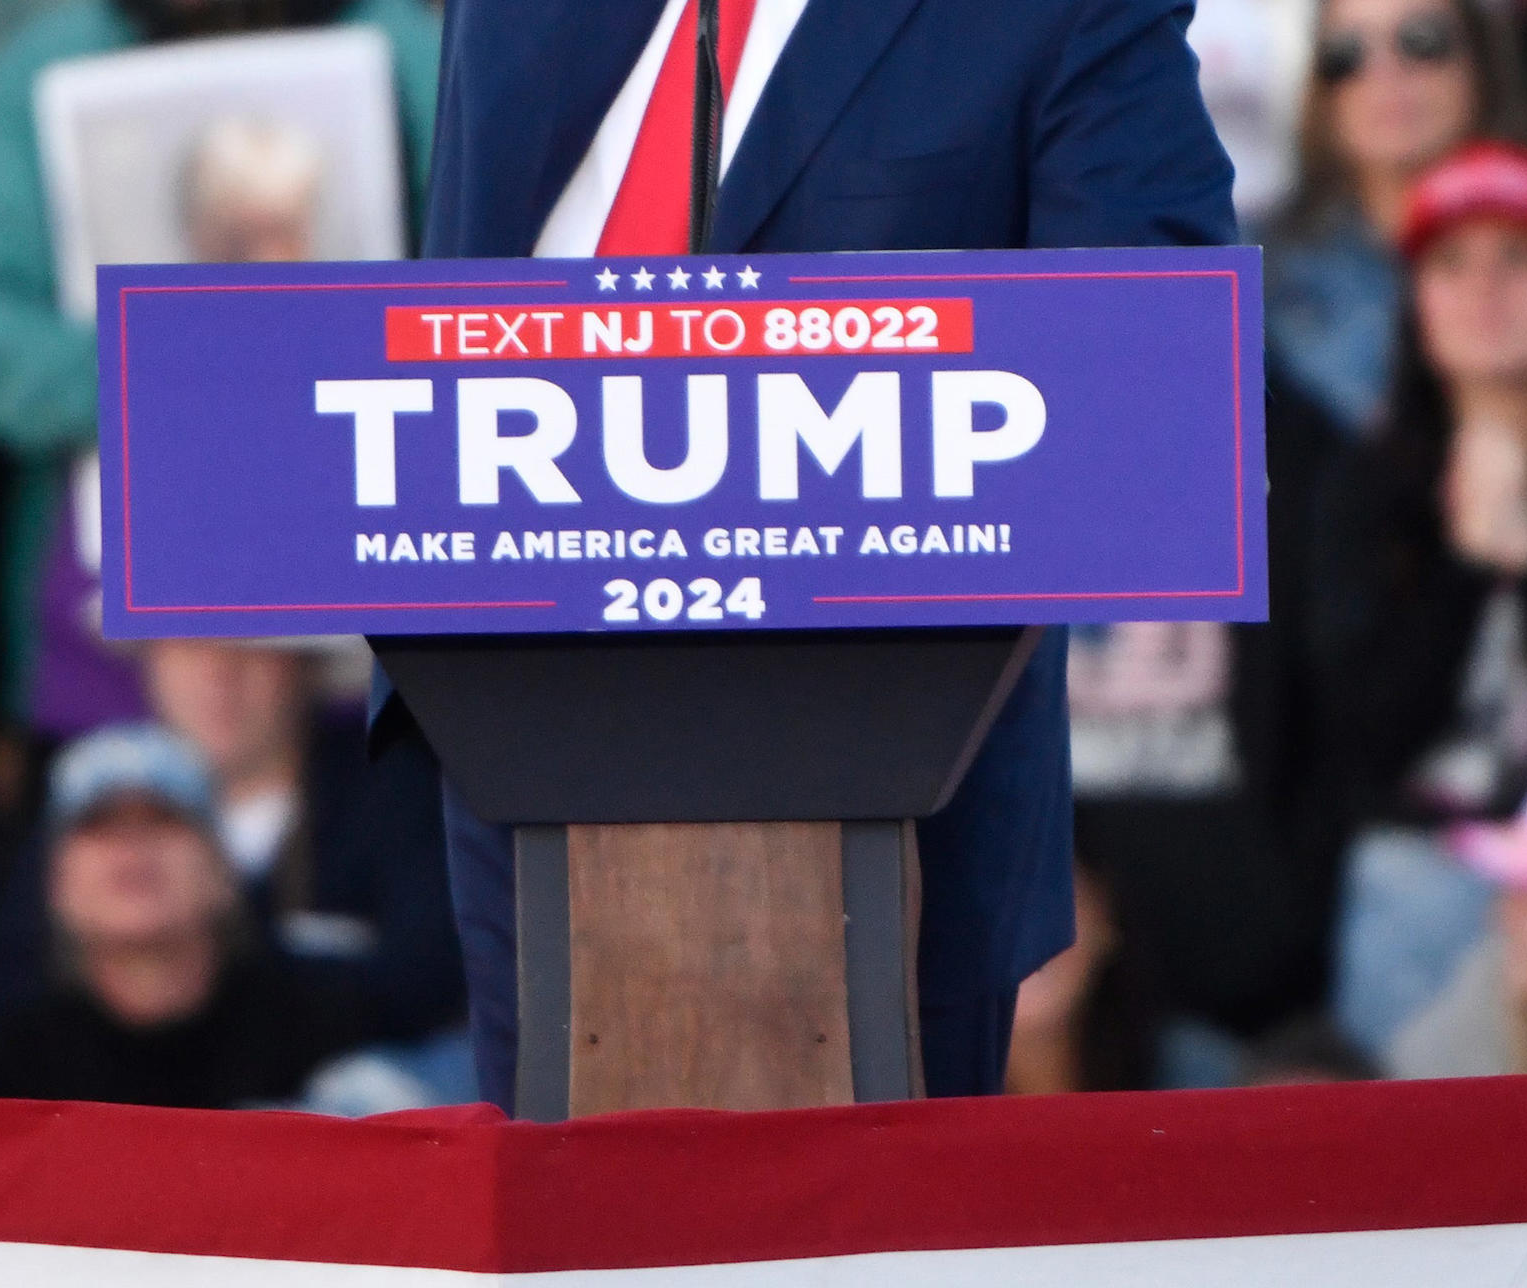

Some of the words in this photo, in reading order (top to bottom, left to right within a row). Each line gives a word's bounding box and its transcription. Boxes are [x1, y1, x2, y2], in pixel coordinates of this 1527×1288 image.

[420, 312, 564, 355] TEXT
[581, 310, 654, 353] NJ
[670, 309, 747, 352] TO
[764, 305, 940, 350] 88022
[314, 369, 1048, 507] TRUMP
[355, 532, 477, 563] MAKE
[491, 528, 689, 561] AMERICA
[703, 526, 845, 558] GREAT
[859, 523, 1012, 555] AGAIN!
[602, 577, 767, 622] 2024
